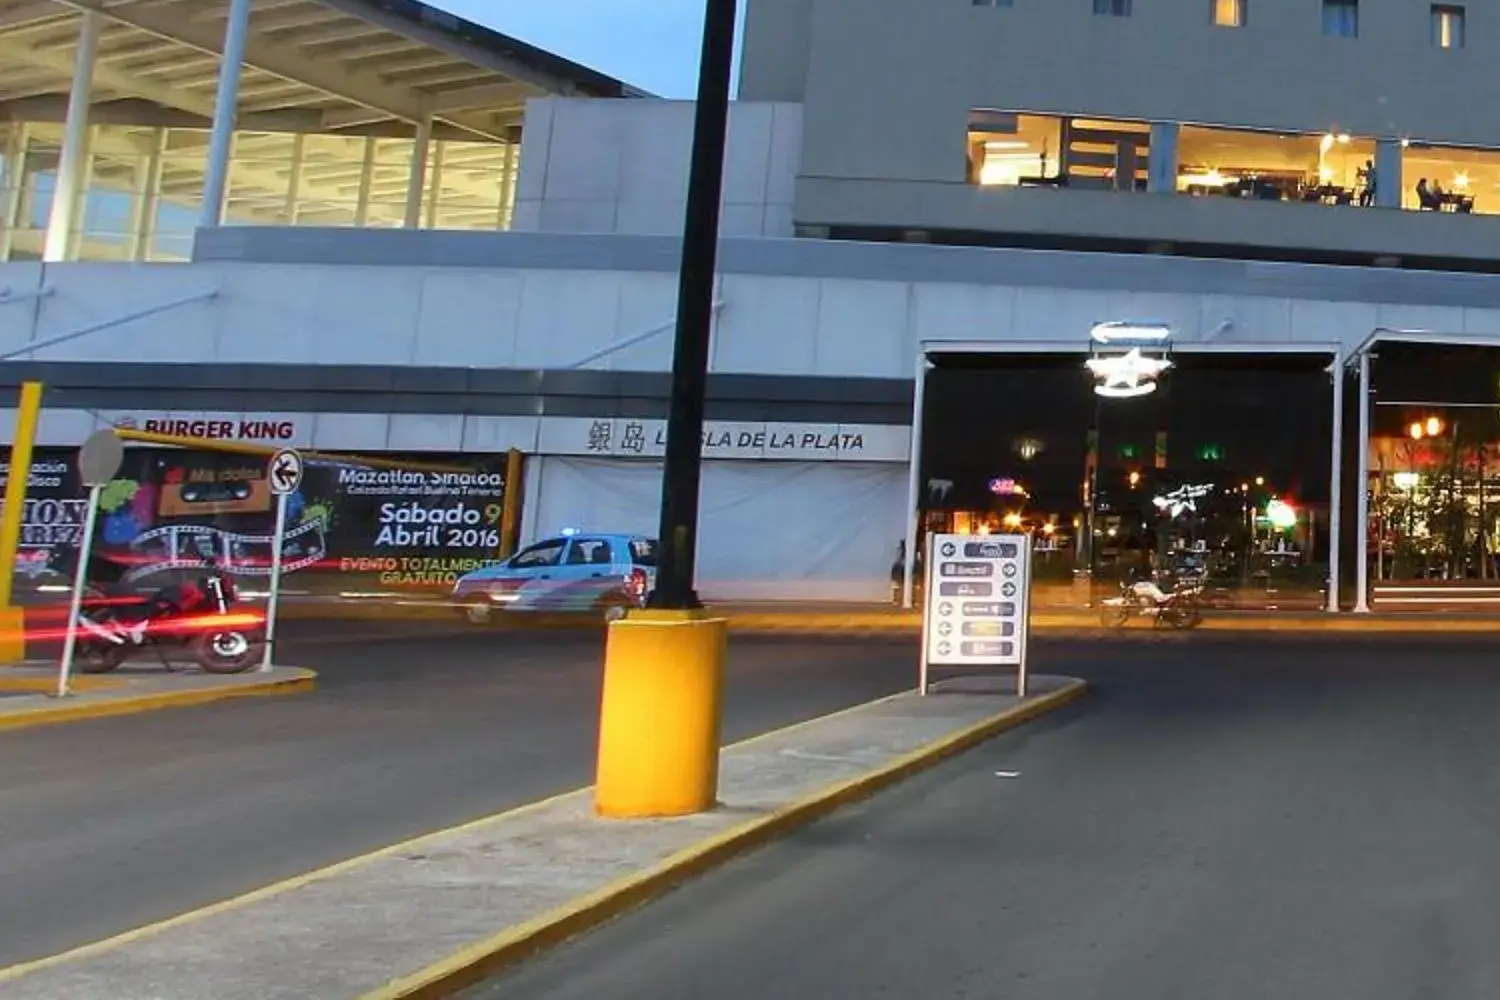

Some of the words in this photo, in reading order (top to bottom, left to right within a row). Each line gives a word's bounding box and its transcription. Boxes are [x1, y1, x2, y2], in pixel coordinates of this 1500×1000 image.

[145, 419, 233, 439] BURGER
[238, 422, 293, 439] KING
[737, 432, 765, 448] DE
[769, 433, 795, 449] LA
[800, 434, 864, 450] PLATA
[379, 501, 480, 524] Sábado
[484, 504, 500, 524] 9
[374, 525, 440, 546] Abril
[447, 529, 499, 547] 2016
[339, 557, 398, 571] EVENTO
